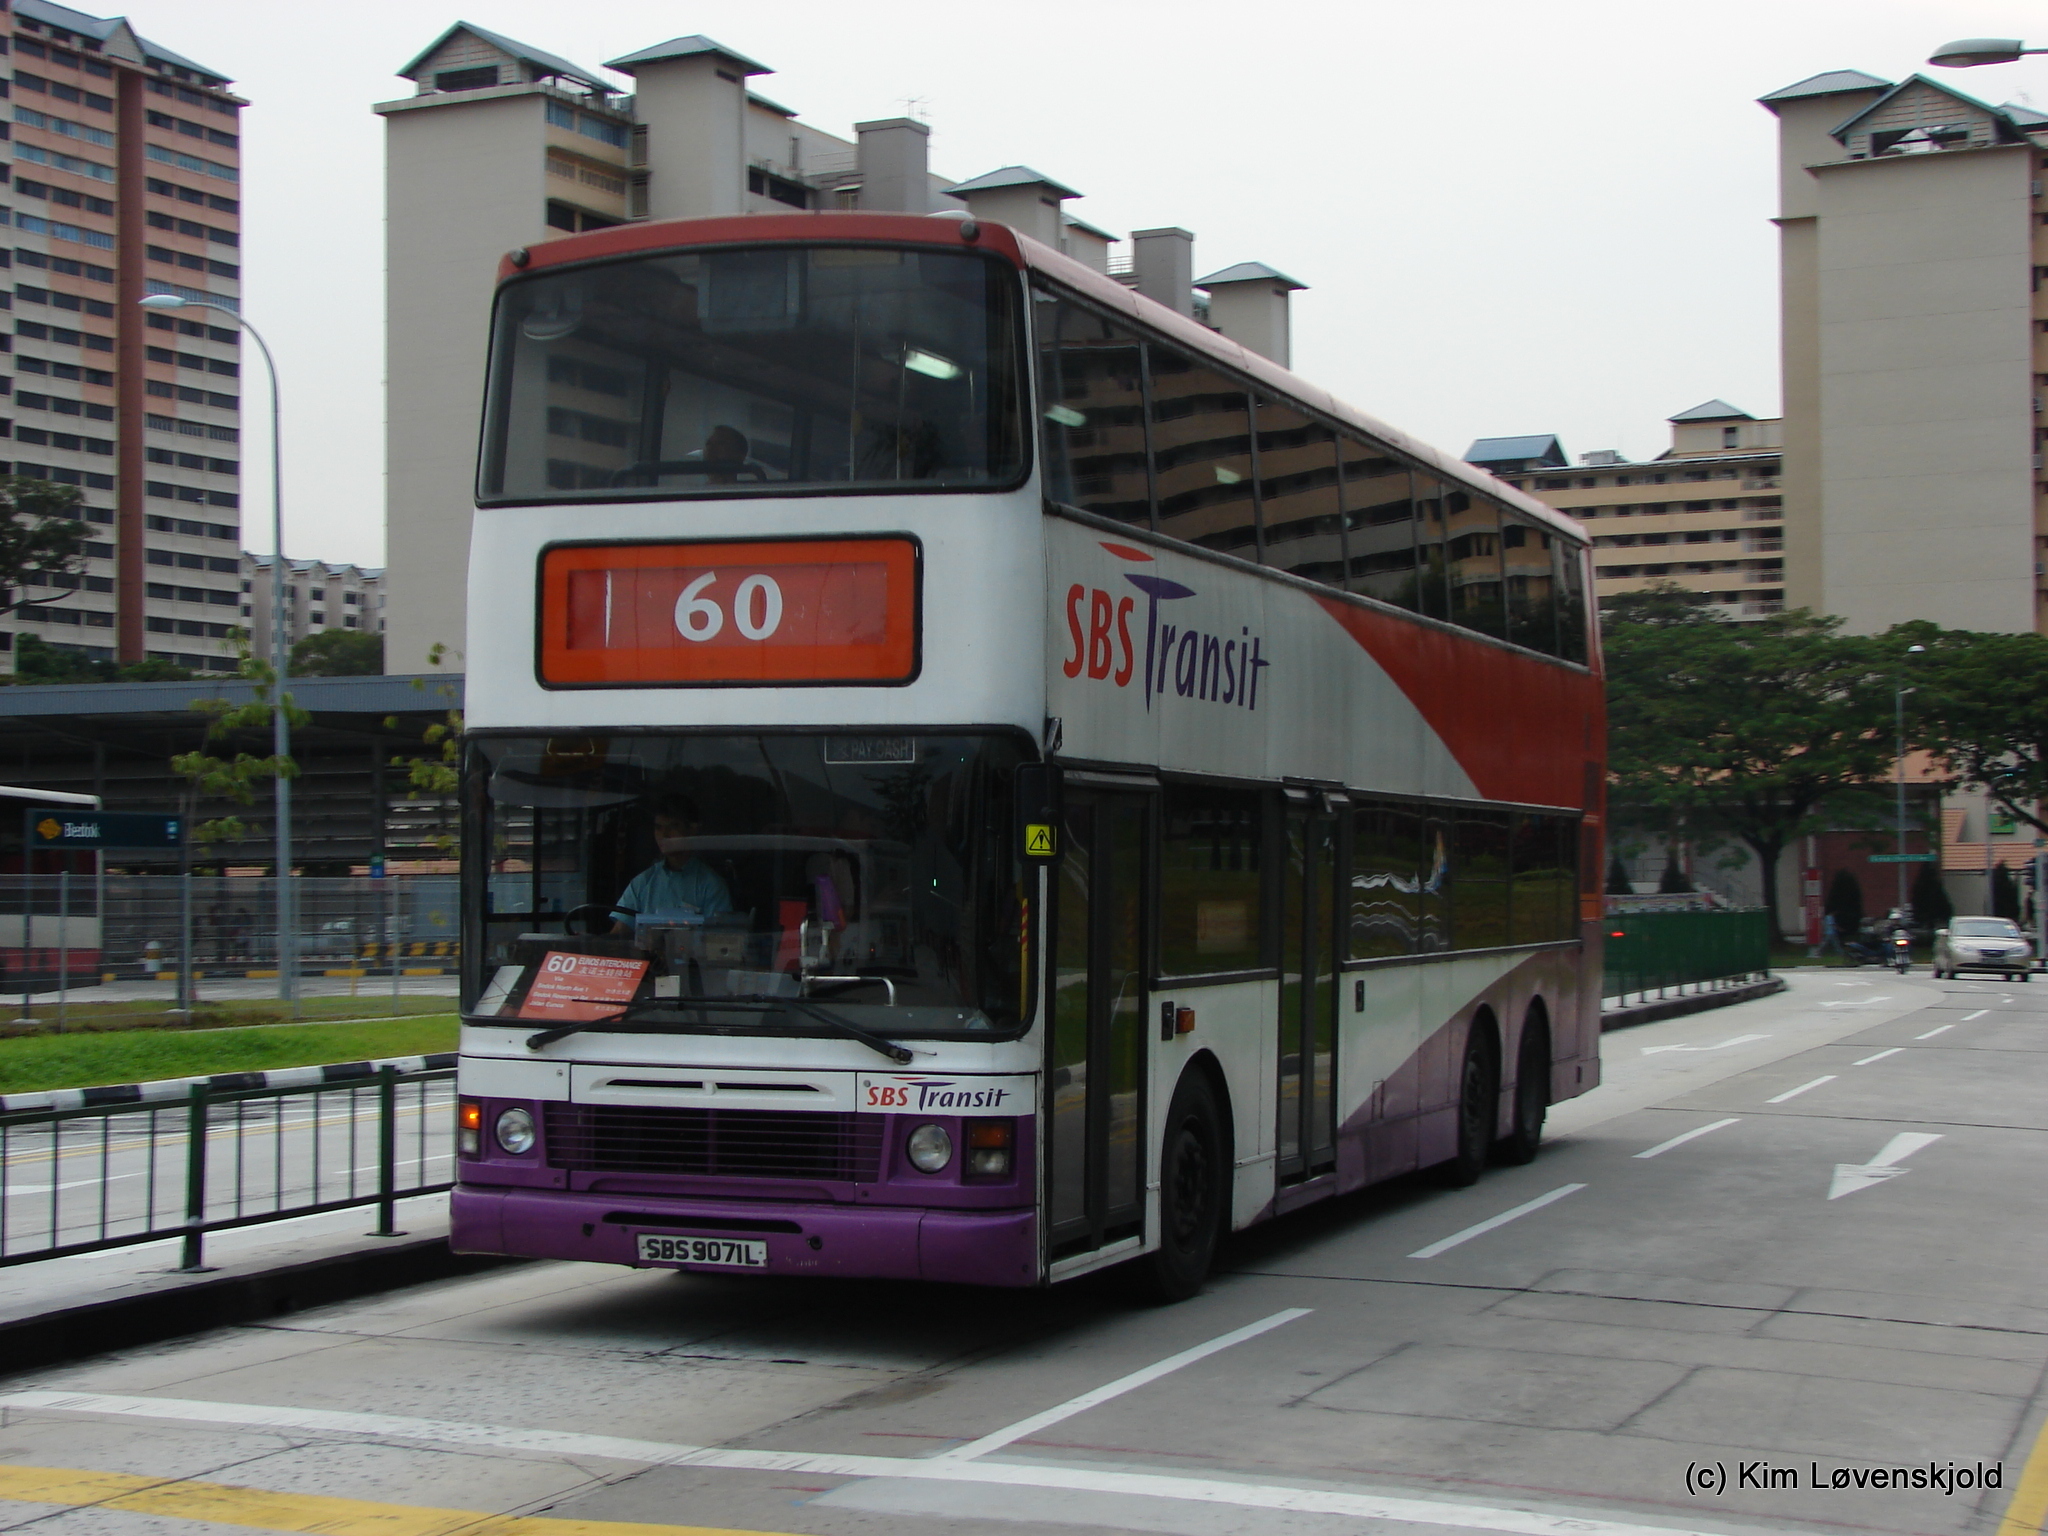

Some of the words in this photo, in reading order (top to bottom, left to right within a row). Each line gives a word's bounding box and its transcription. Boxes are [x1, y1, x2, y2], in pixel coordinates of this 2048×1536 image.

[674, 571, 783, 642] 60
[1063, 583, 1134, 688] SBS
[1123, 573, 1270, 715] Transit
[547, 955, 577, 973] 60
[867, 1086, 909, 1106] SBS
[906, 1081, 1012, 1112] Transit
